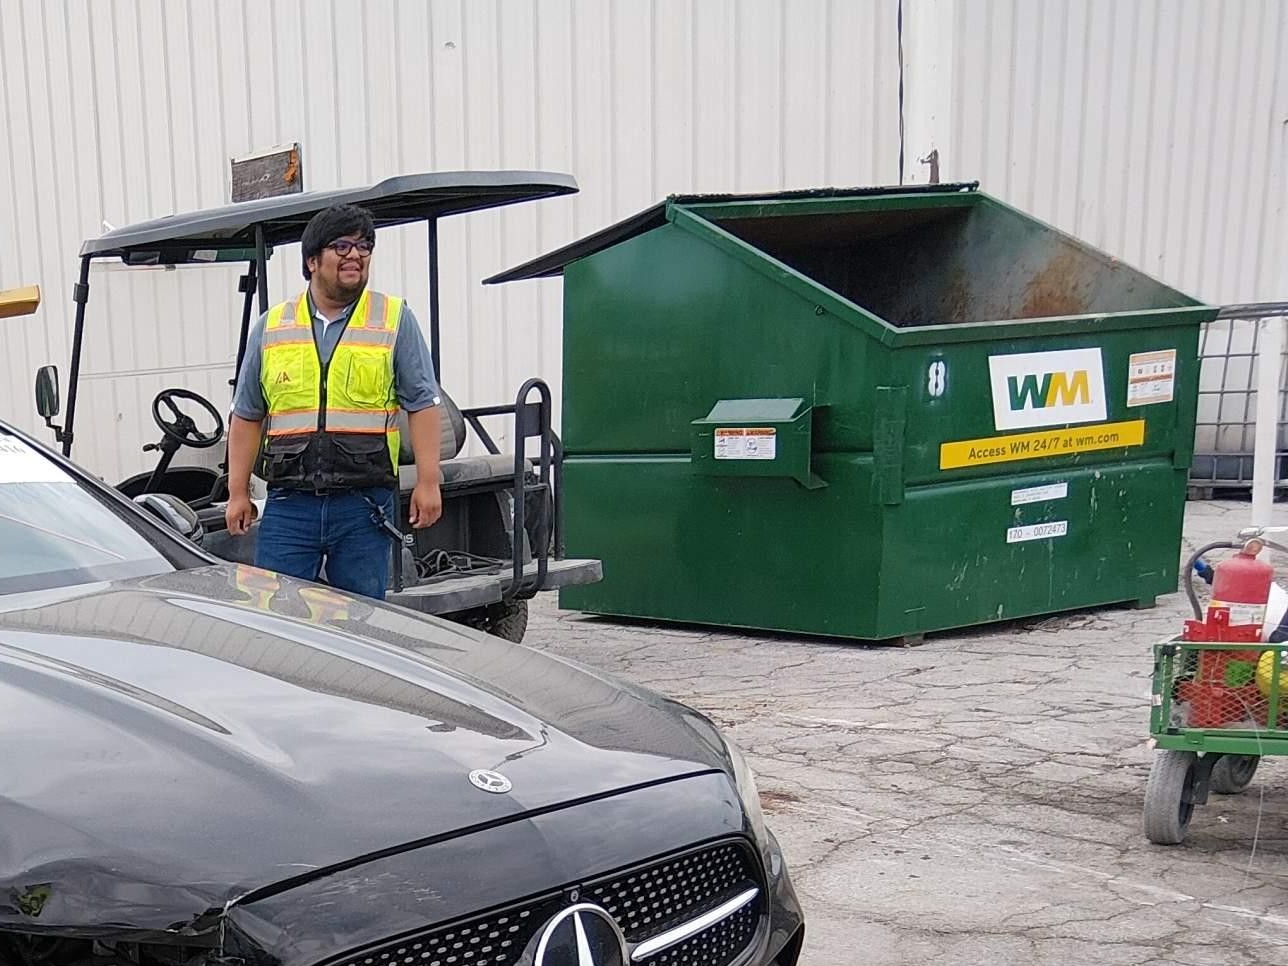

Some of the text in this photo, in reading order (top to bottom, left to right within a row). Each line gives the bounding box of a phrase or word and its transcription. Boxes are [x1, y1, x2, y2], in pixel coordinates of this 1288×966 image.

[1007, 370, 1090, 411] WM
[968, 432, 1119, 460] Access WM 24/7 at wm.com
